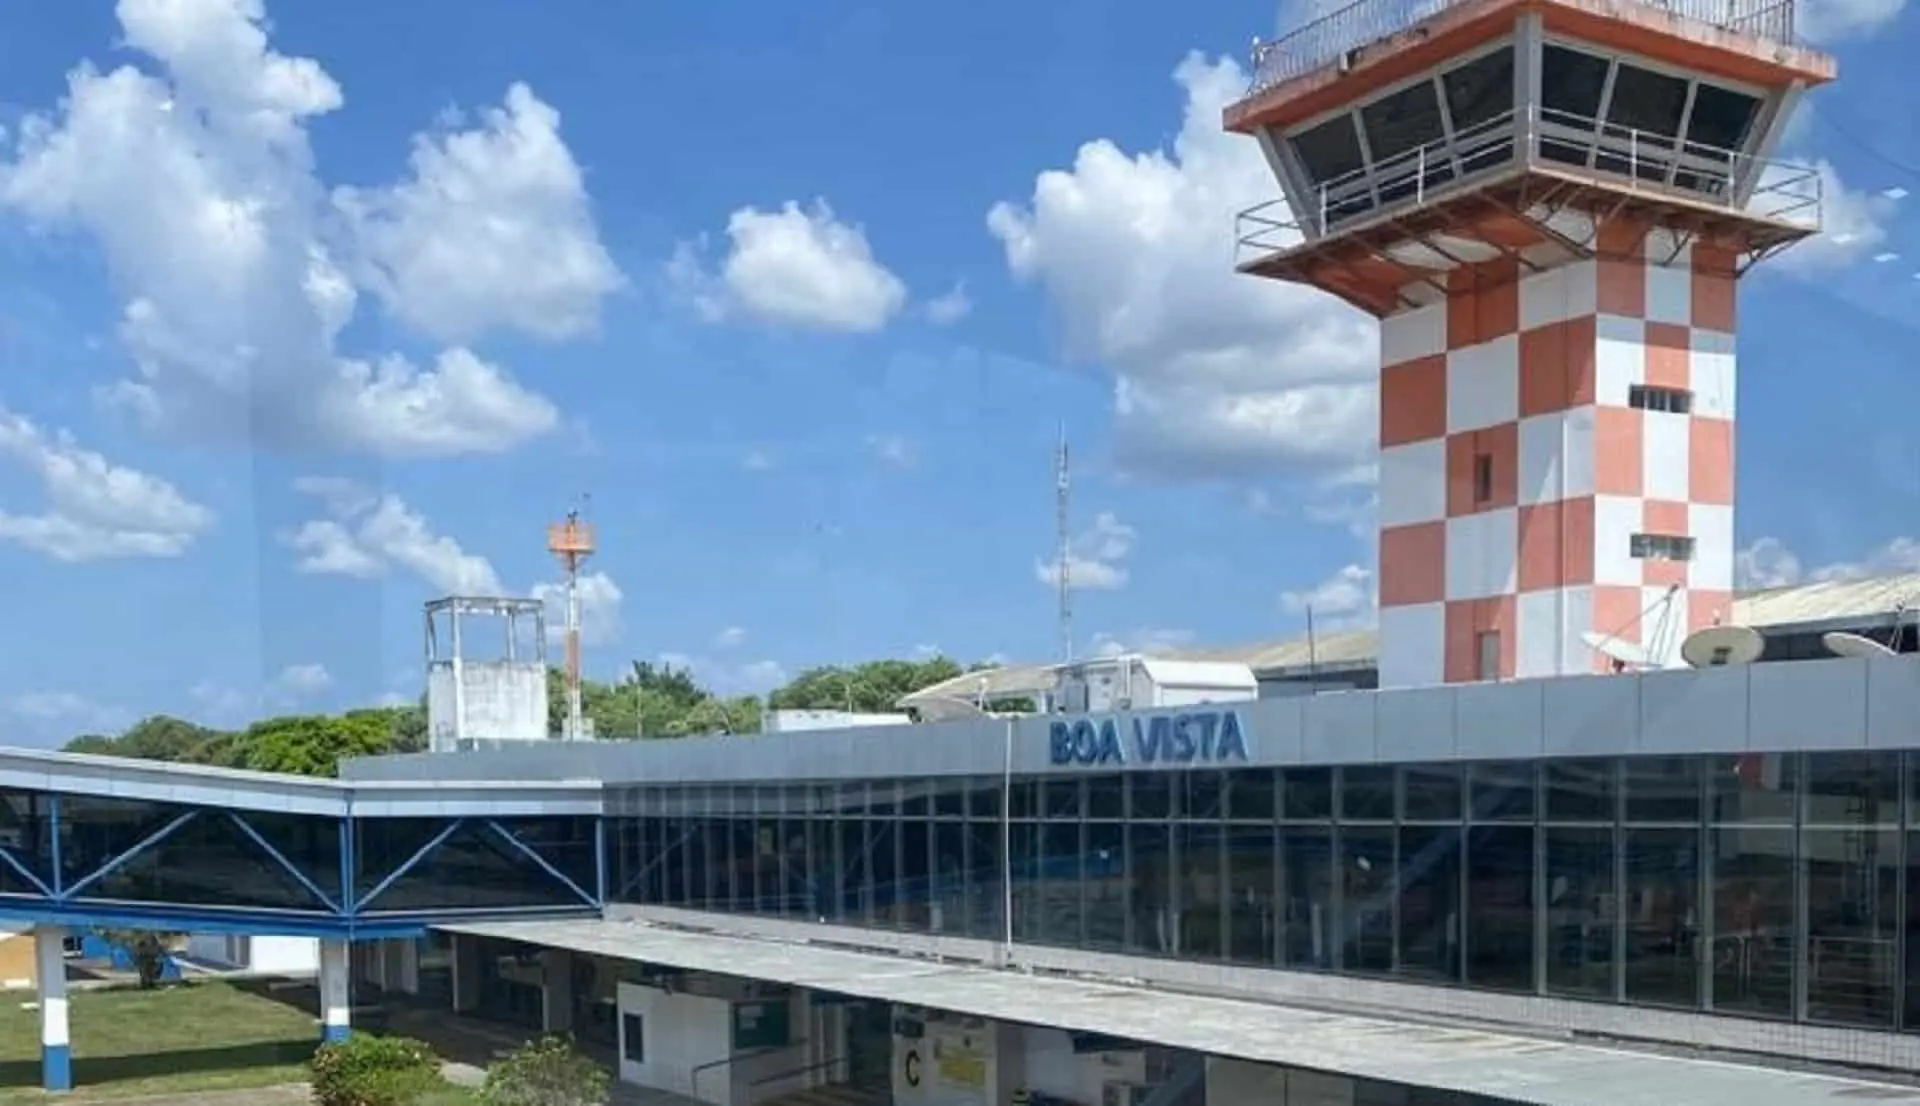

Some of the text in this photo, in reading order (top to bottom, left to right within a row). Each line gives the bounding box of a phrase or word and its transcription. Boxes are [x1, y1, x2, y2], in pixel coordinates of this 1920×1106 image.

[1050, 711, 1248, 764] BOA VISTA
[905, 1048, 920, 1087] C
